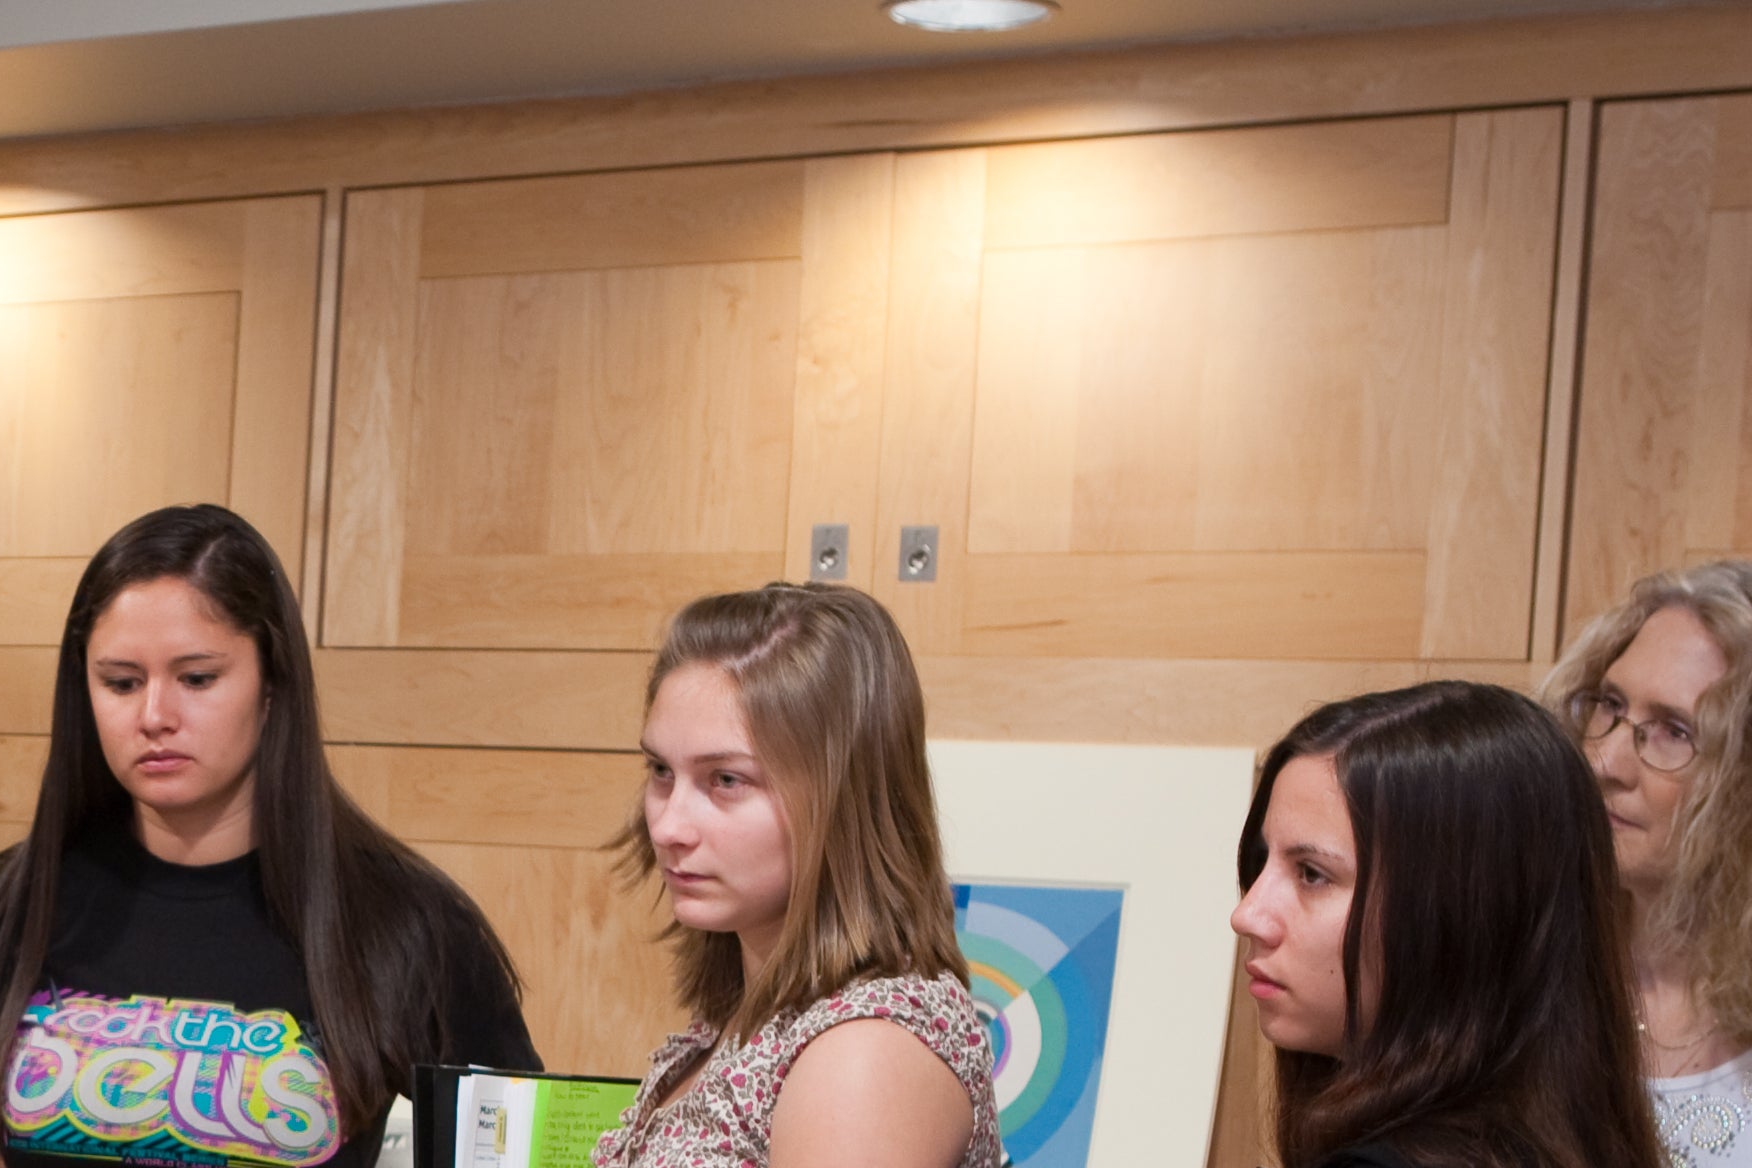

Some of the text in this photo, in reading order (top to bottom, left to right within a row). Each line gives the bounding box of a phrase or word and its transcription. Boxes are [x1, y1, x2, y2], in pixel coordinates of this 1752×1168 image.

[45, 1006, 281, 1053] rock the
[8, 1026, 329, 1150] bells
[480, 1105, 499, 1116] Marc
[478, 1119, 497, 1131] Marc
[125, 1157, 133, 1165] A
[135, 1157, 174, 1168] WORLD
